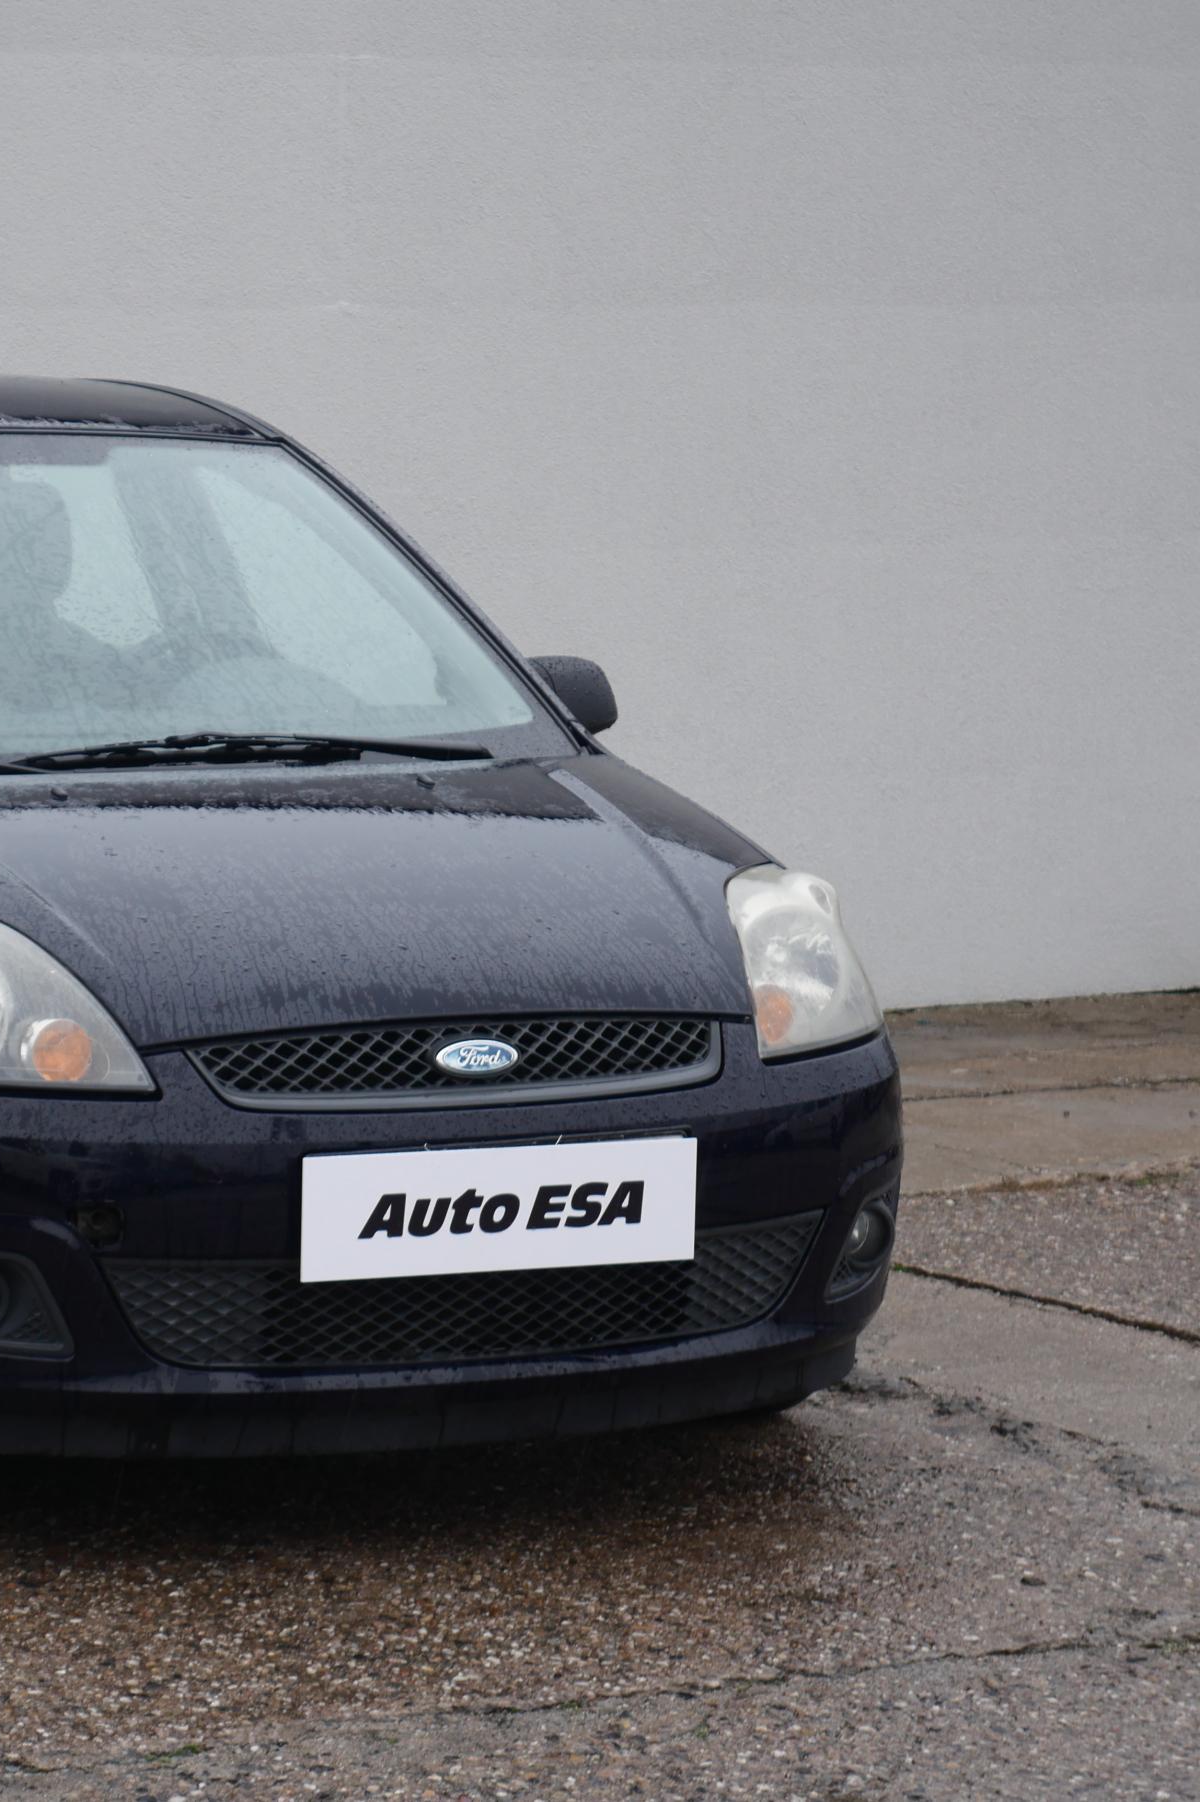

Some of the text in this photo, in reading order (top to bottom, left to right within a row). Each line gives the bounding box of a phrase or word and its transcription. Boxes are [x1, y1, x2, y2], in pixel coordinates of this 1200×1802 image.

[458, 1045, 501, 1066] Ford
[358, 1180, 645, 1240] Auto ESA
